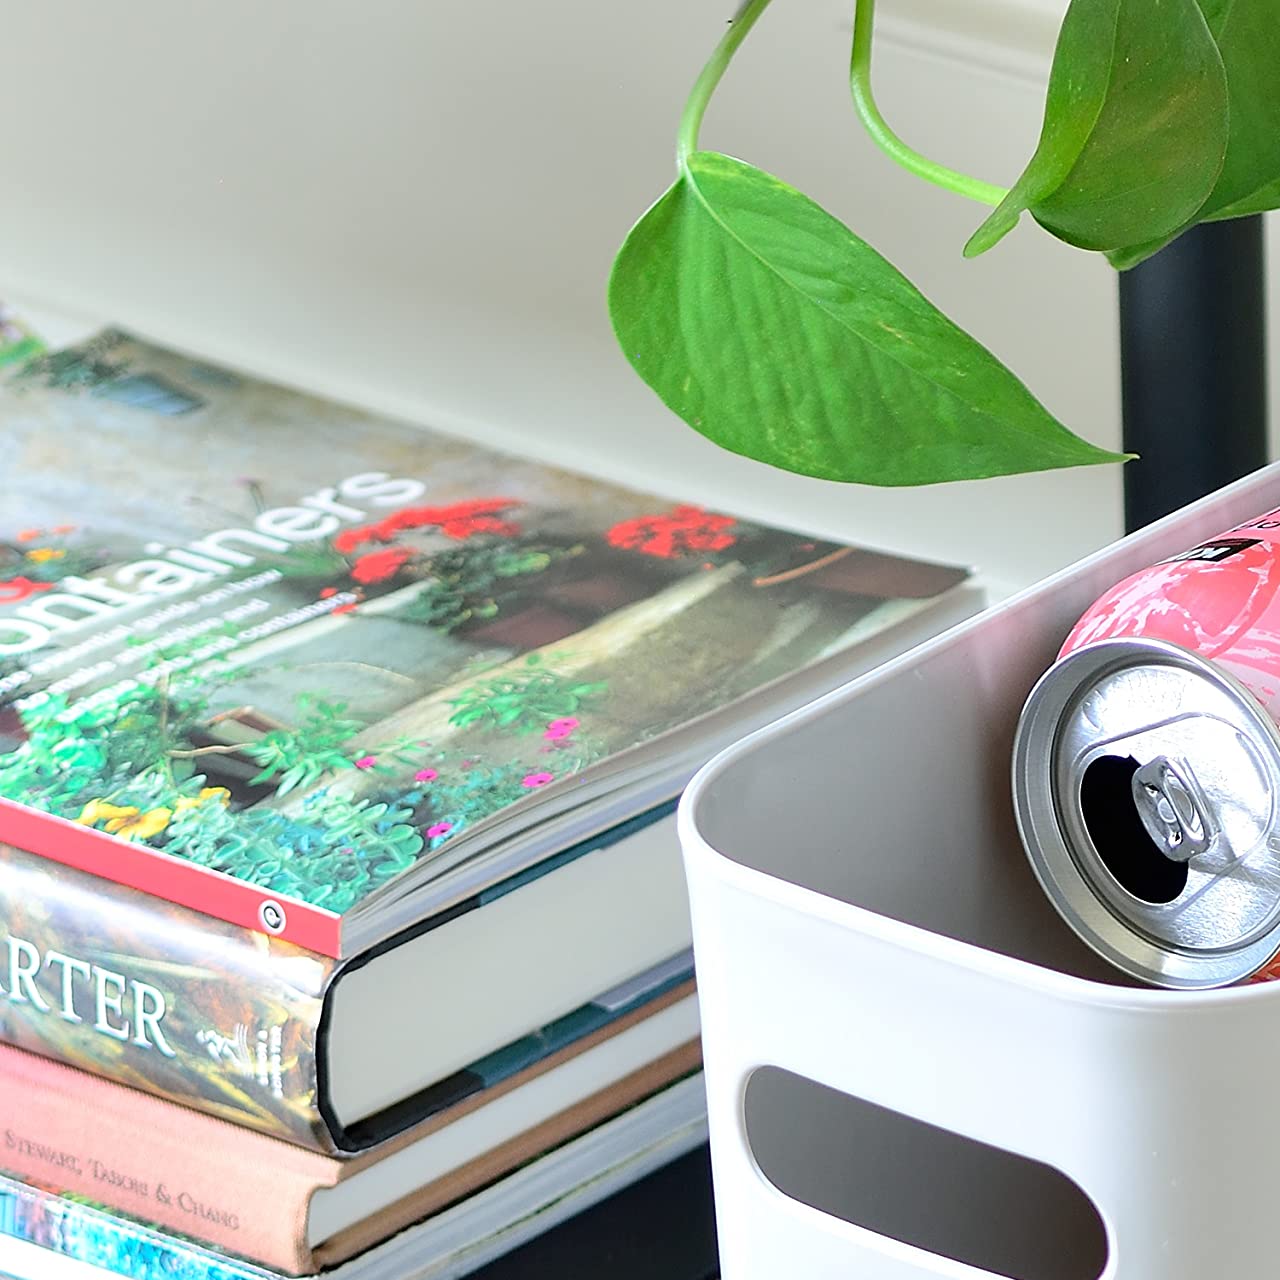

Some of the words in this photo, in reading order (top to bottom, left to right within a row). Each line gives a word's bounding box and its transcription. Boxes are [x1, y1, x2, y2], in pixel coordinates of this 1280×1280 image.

[0, 471, 427, 656] ontainers
[0, 935, 177, 1058] RTER
[155, 1182, 173, 1207] &
